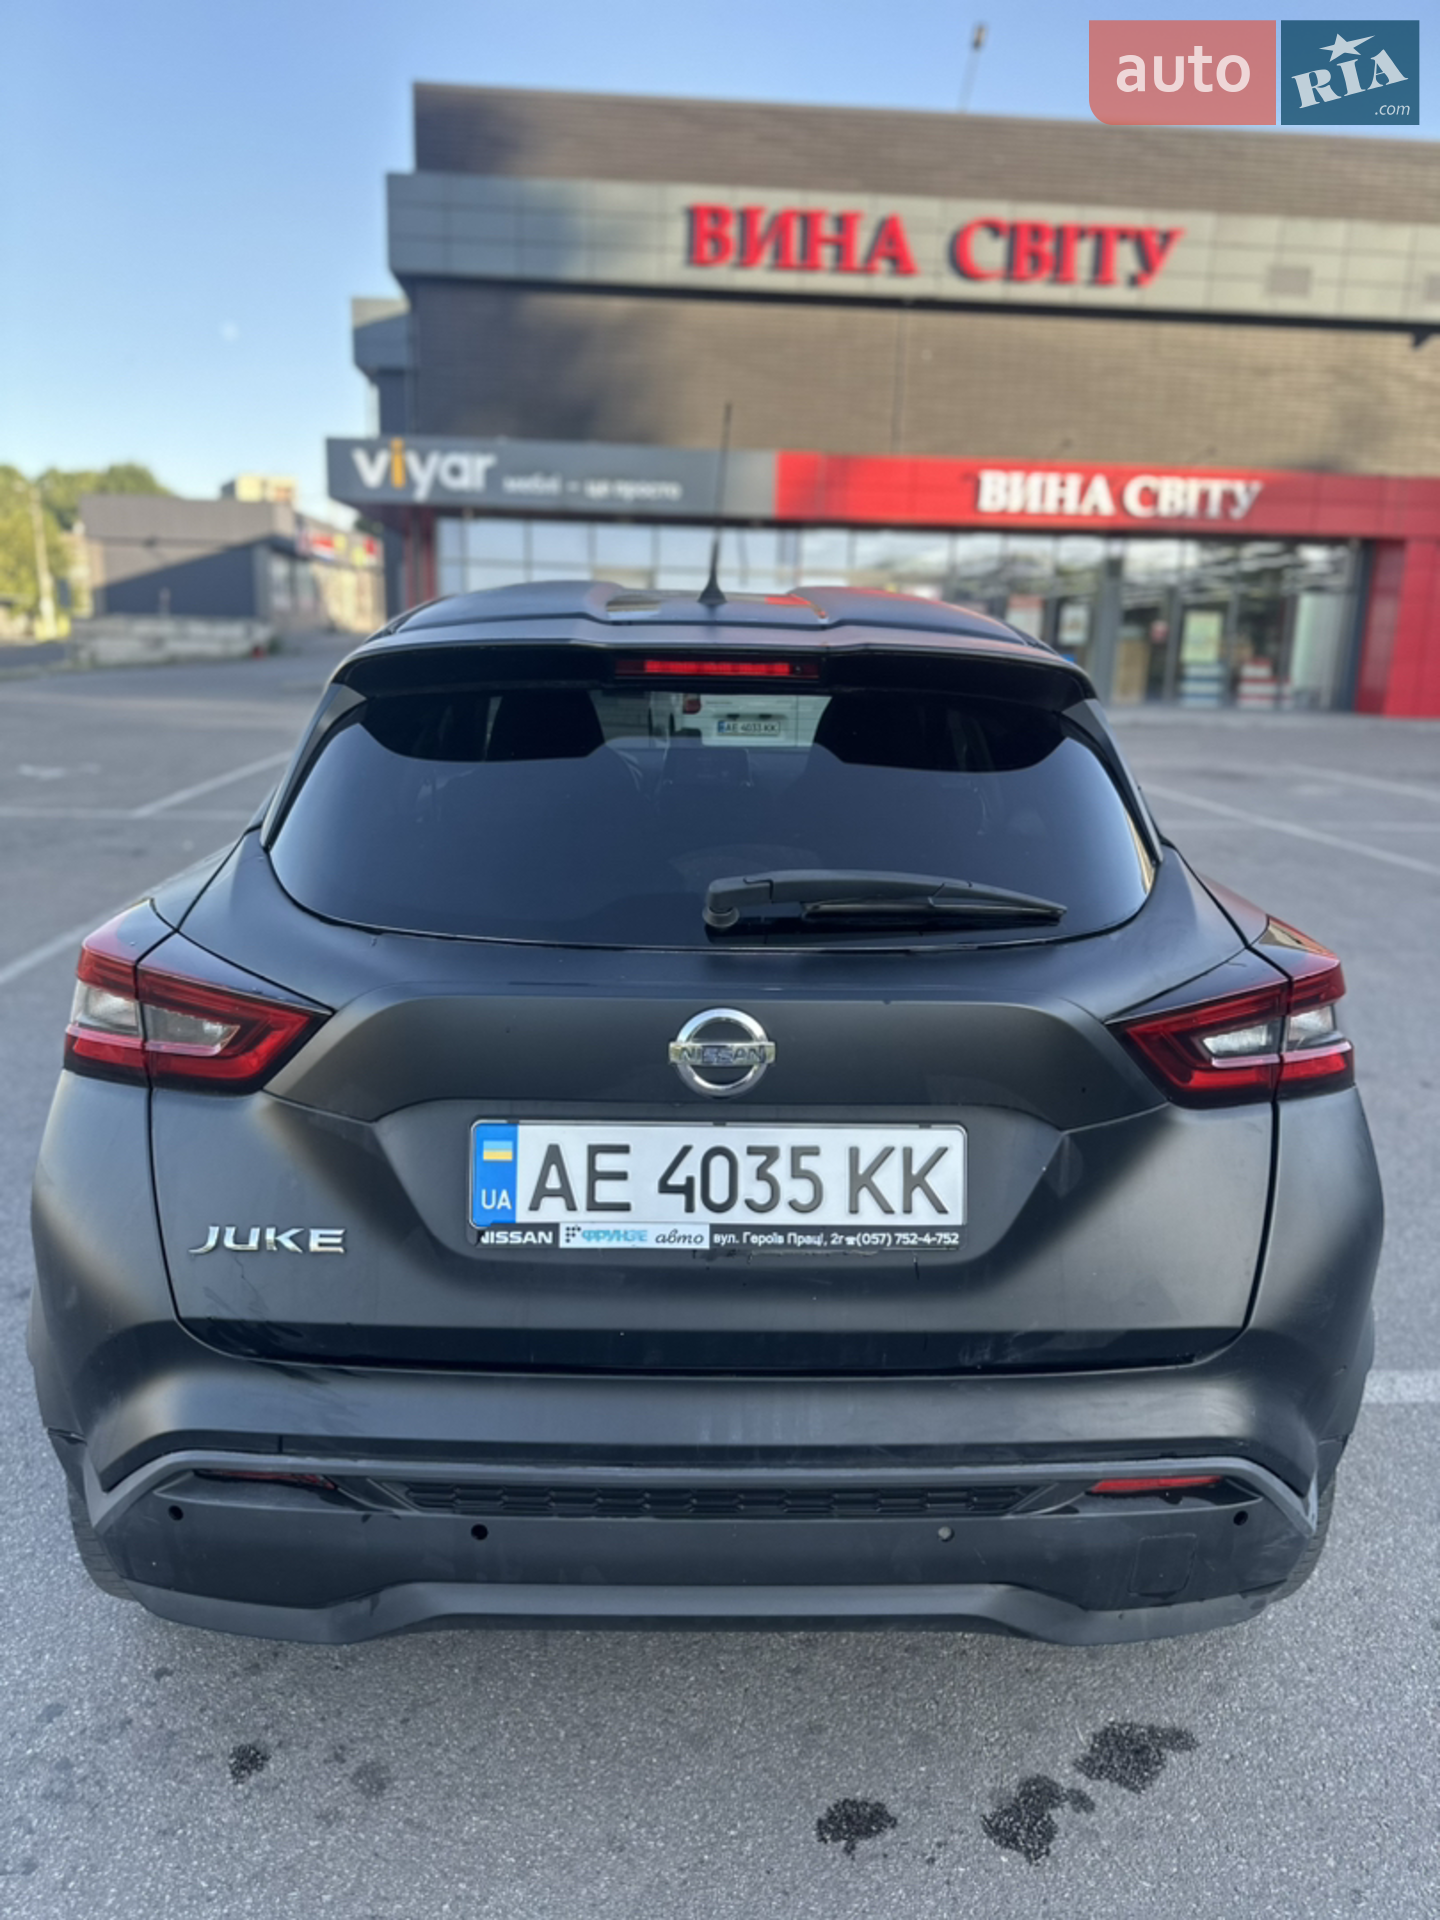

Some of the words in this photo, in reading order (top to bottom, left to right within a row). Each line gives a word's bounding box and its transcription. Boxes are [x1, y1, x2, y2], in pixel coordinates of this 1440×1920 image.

[687, 203, 919, 277] ВИНА
[949, 217, 1186, 288] СВІТУ
[352, 437, 497, 502] viyar
[978, 469, 1116, 516] ВИНА
[1122, 475, 1264, 520] СВІТУ
[680, 1045, 767, 1063] NISSAN
[528, 1143, 632, 1212] AE
[657, 1144, 823, 1214] 4035
[848, 1146, 949, 1215] KK
[481, 1190, 511, 1210] UA
[188, 1225, 346, 1254] JUKE
[655, 1229, 704, 1244] авто
[713, 1233, 739, 1245] вул.
[743, 1232, 784, 1245] Героїв
[894, 1232, 960, 1246] 752-4-752
